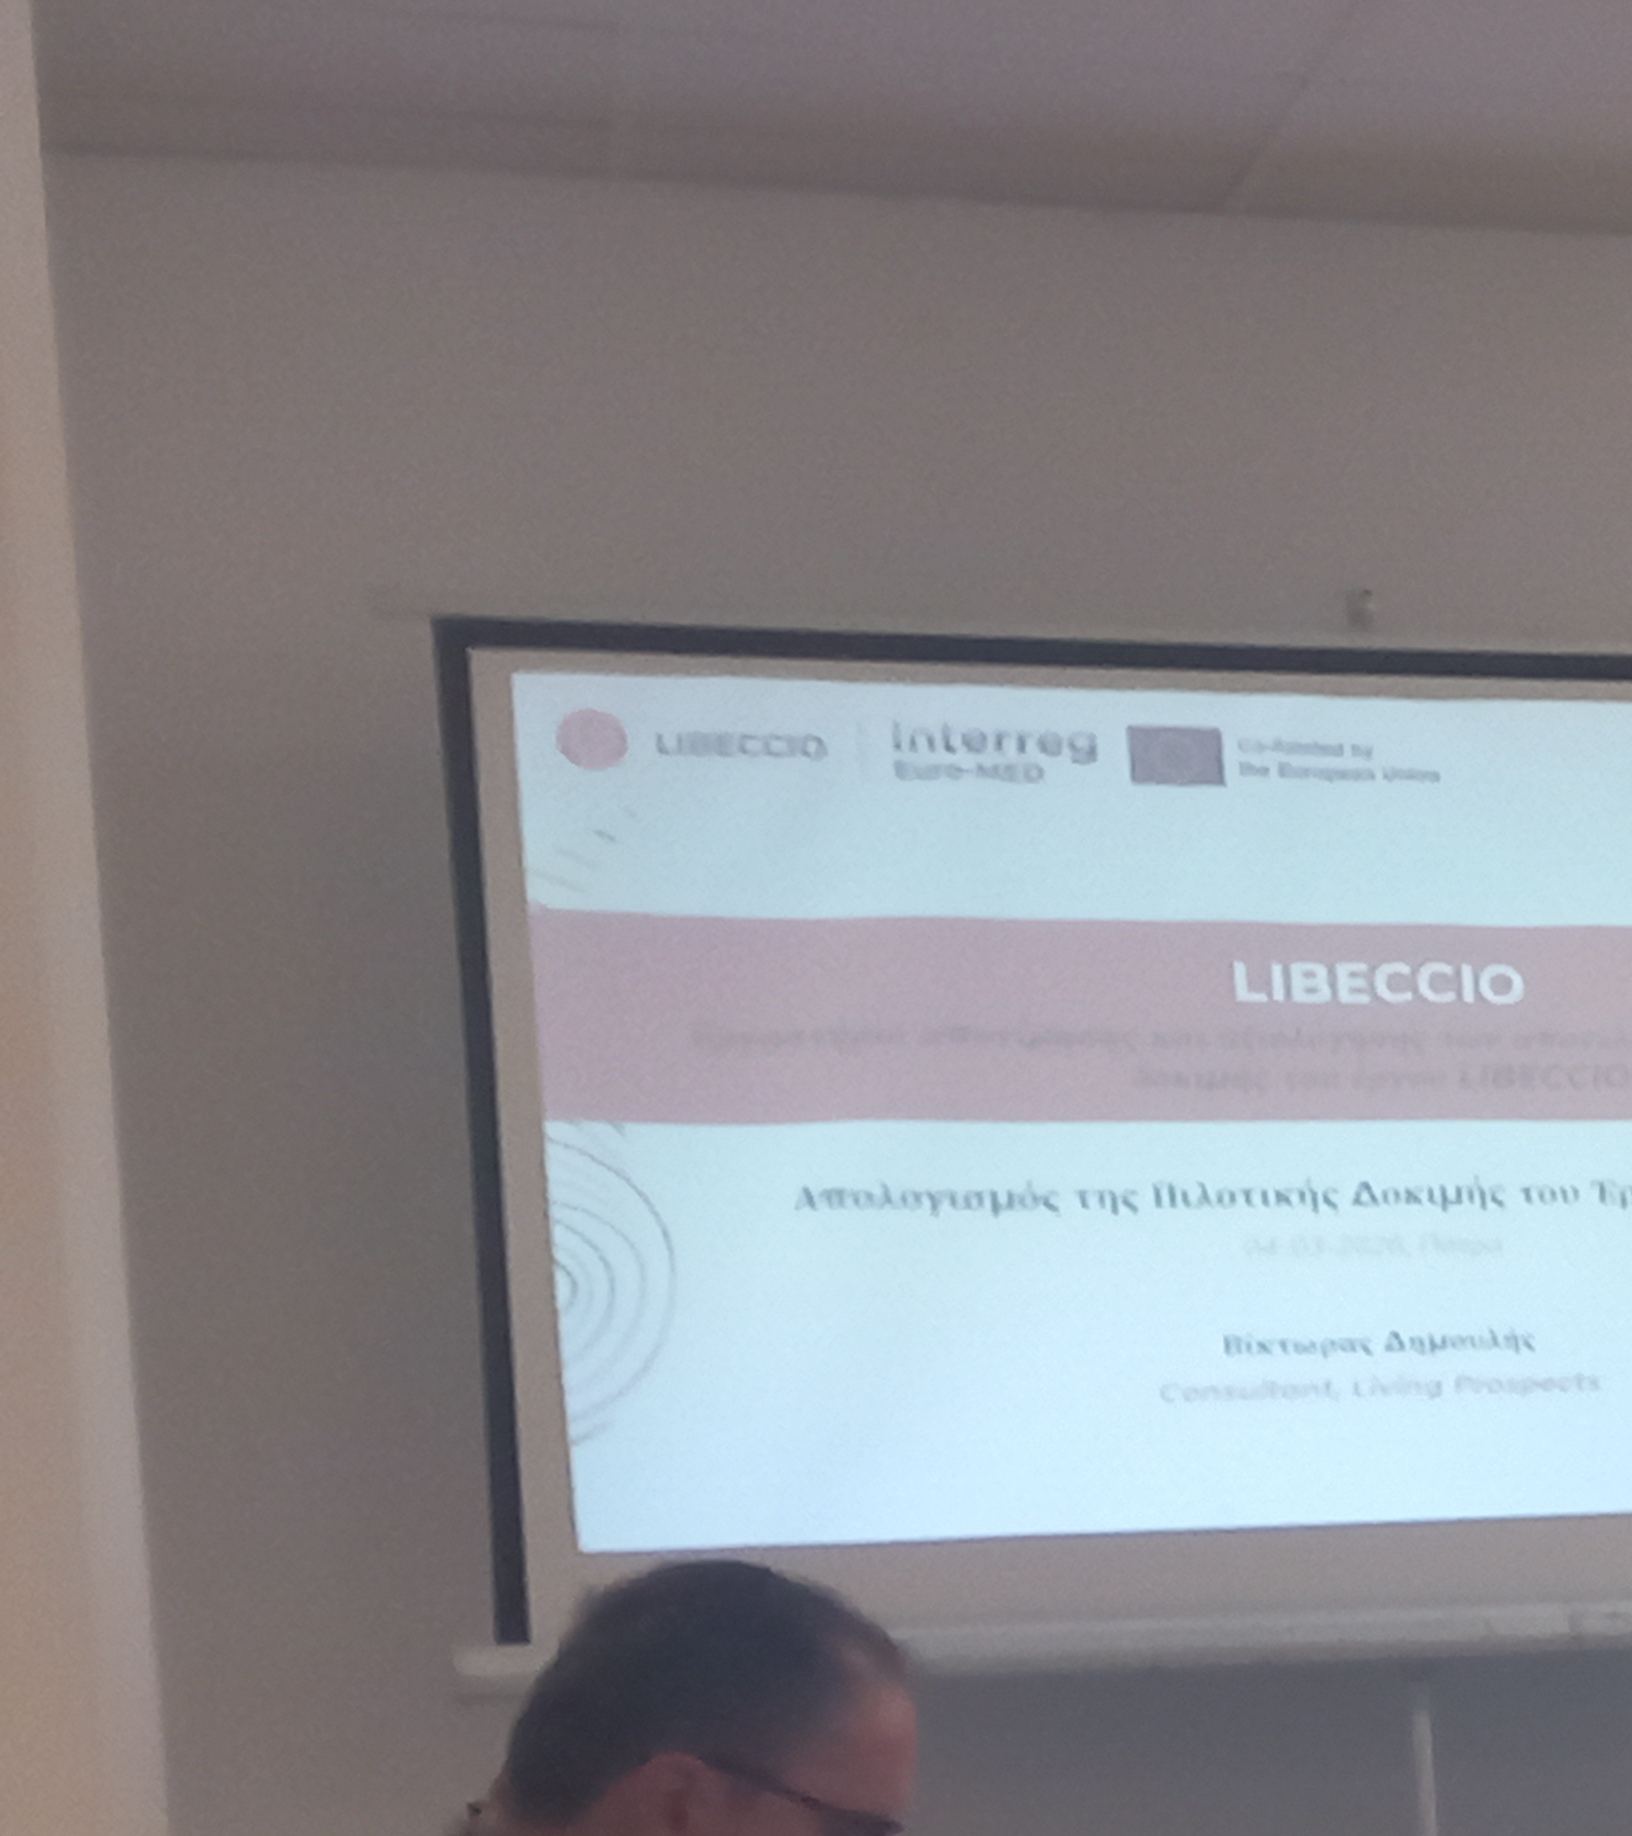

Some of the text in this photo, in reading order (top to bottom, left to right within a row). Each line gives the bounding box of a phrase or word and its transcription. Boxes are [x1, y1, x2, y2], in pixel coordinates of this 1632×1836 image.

[655, 731, 829, 761] LIBECCIO
[892, 719, 1099, 767] Interreg
[1231, 960, 1526, 1005] LIBECCIO
[794, 1179, 1060, 1218] Απολογισμός
[1074, 1185, 1139, 1216] της
[1150, 1177, 1340, 1215] Πιλοτικής
[1351, 1175, 1506, 1213] Δοκιμής
[1520, 1183, 1580, 1205] του
